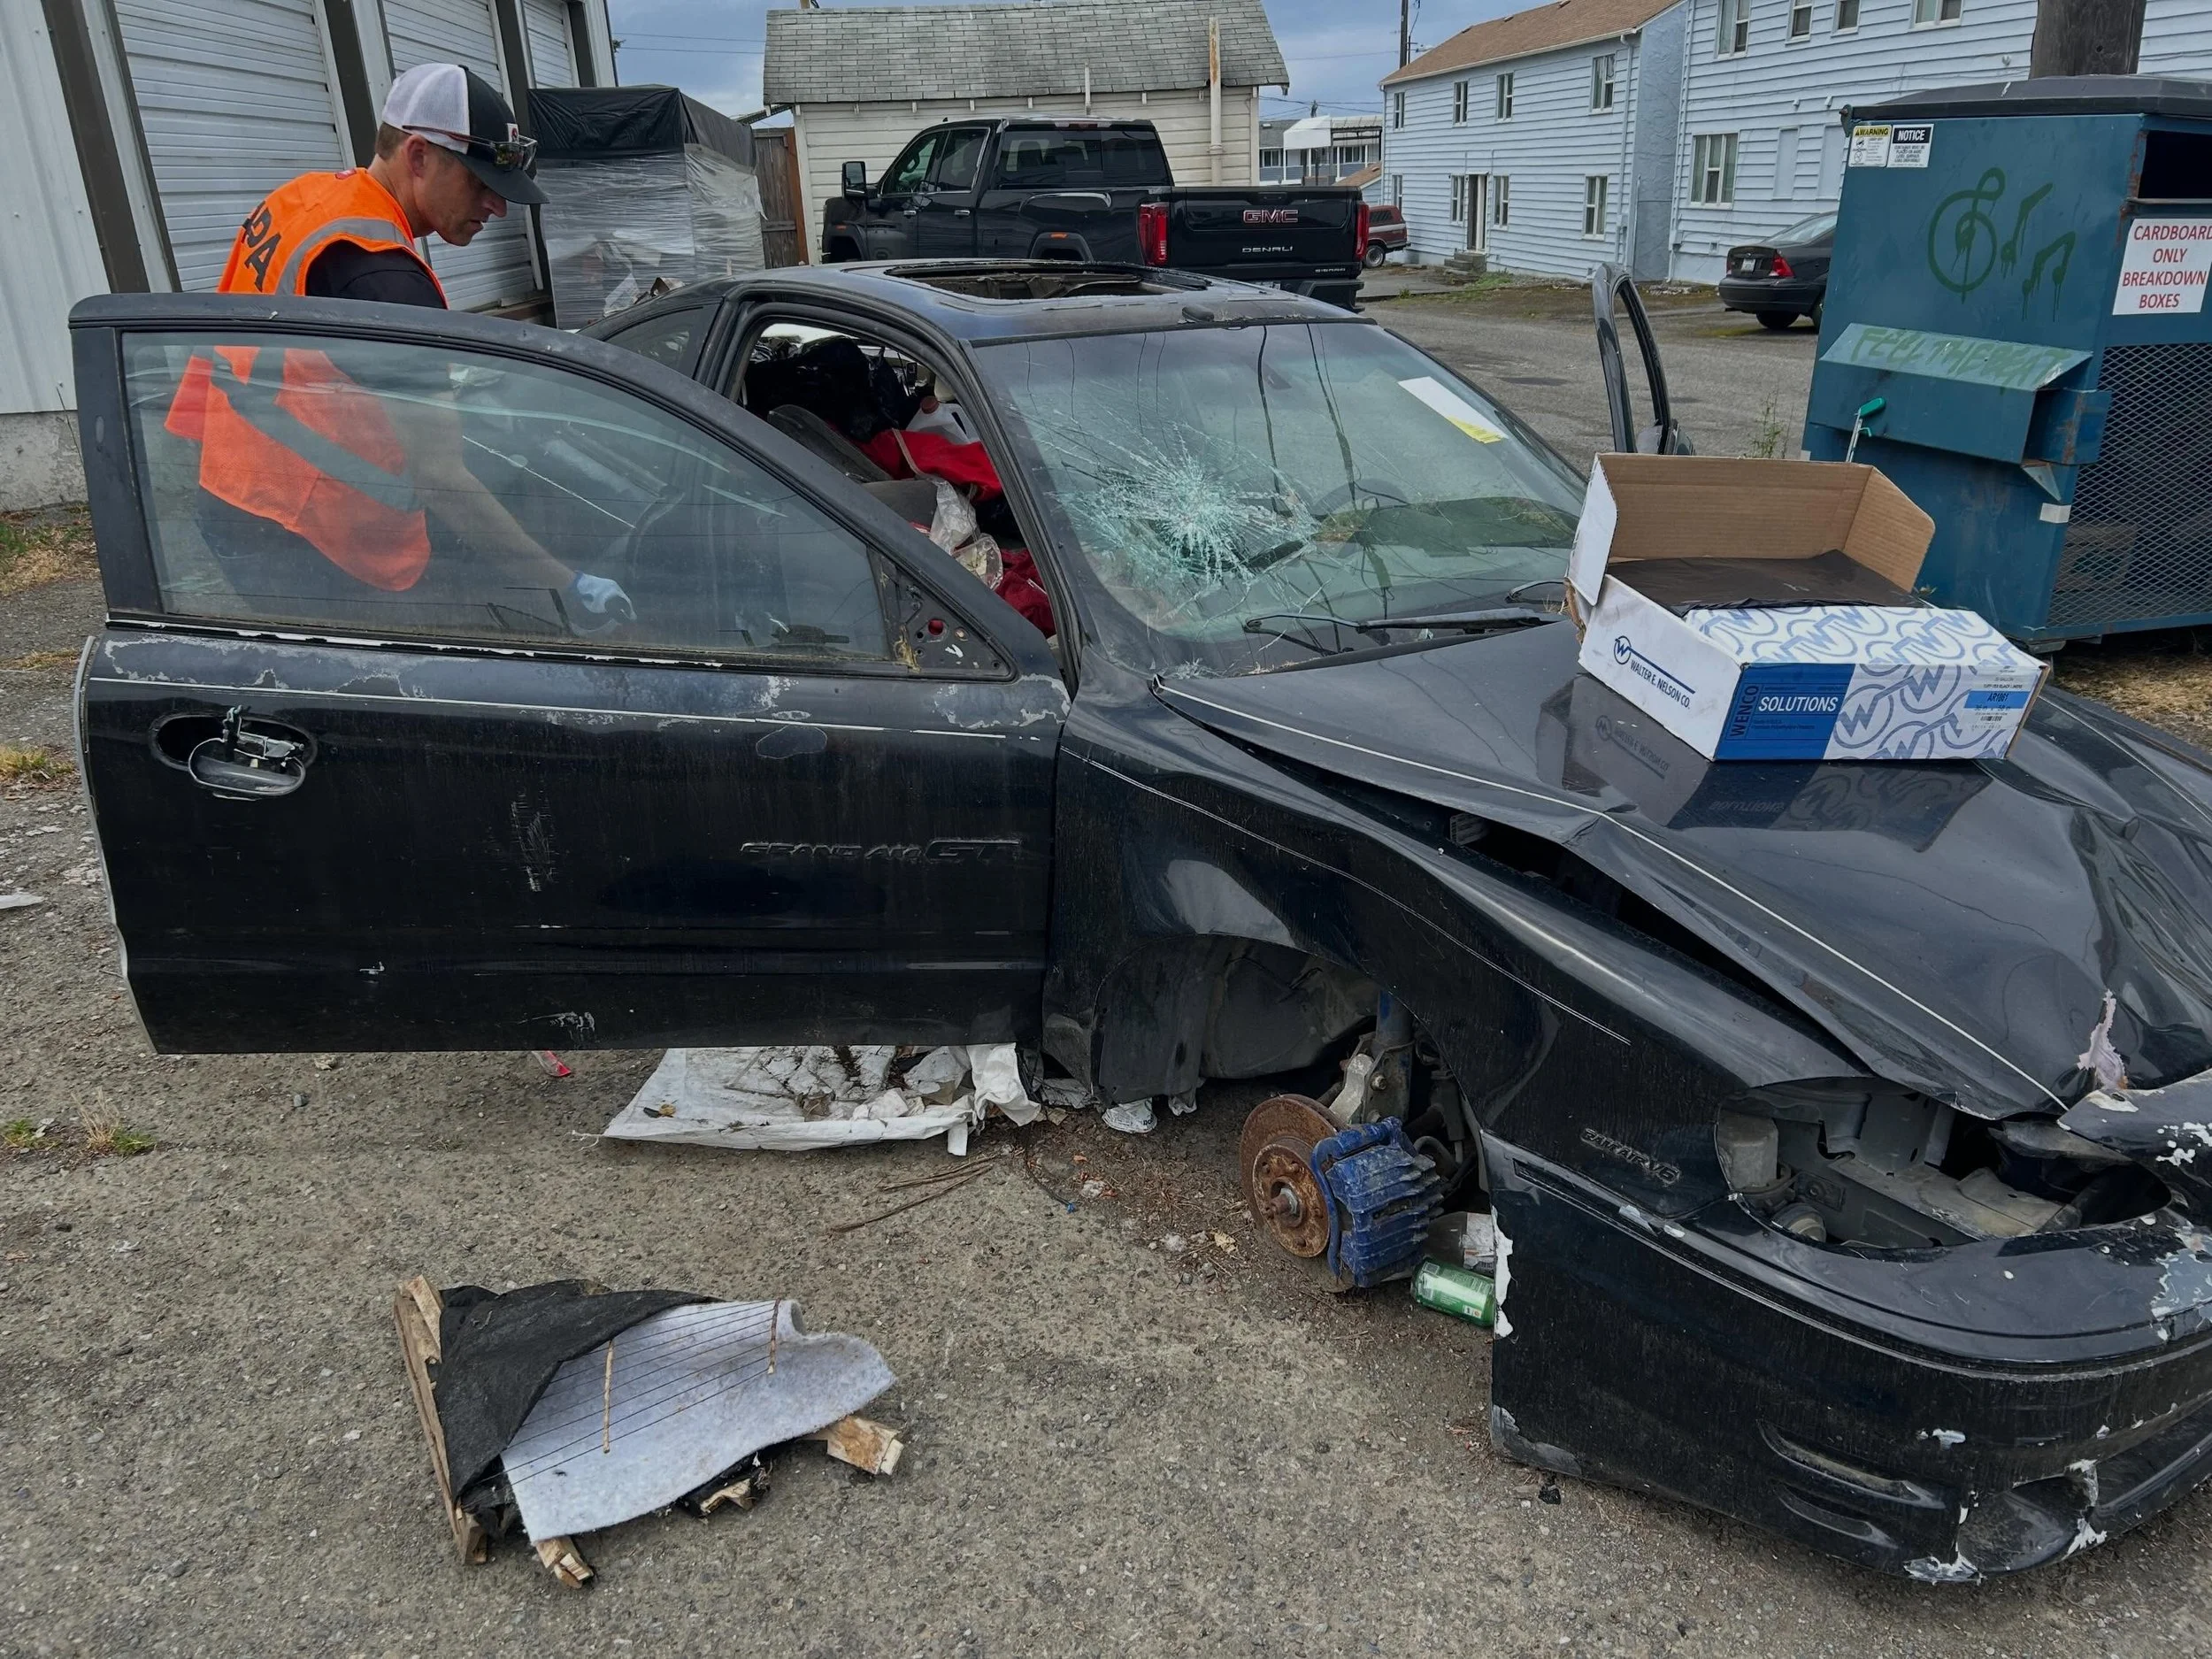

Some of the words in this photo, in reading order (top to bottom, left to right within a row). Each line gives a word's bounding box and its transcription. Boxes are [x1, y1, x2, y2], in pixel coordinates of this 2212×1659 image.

[1897, 129, 1925, 141] NOTICE
[1243, 209, 1298, 223] GMC
[2153, 248, 2187, 263] ONLY
[2123, 271, 2207, 286] BREAKDOWN
[2139, 294, 2180, 308] BOXES
[1630, 660, 1652, 683] WALTER
[1656, 678, 1681, 703] NELSON
[1680, 695, 1691, 710] CO.
[1730, 685, 1759, 737] WENCO
[1758, 695, 1839, 712] SOLUTIONS
